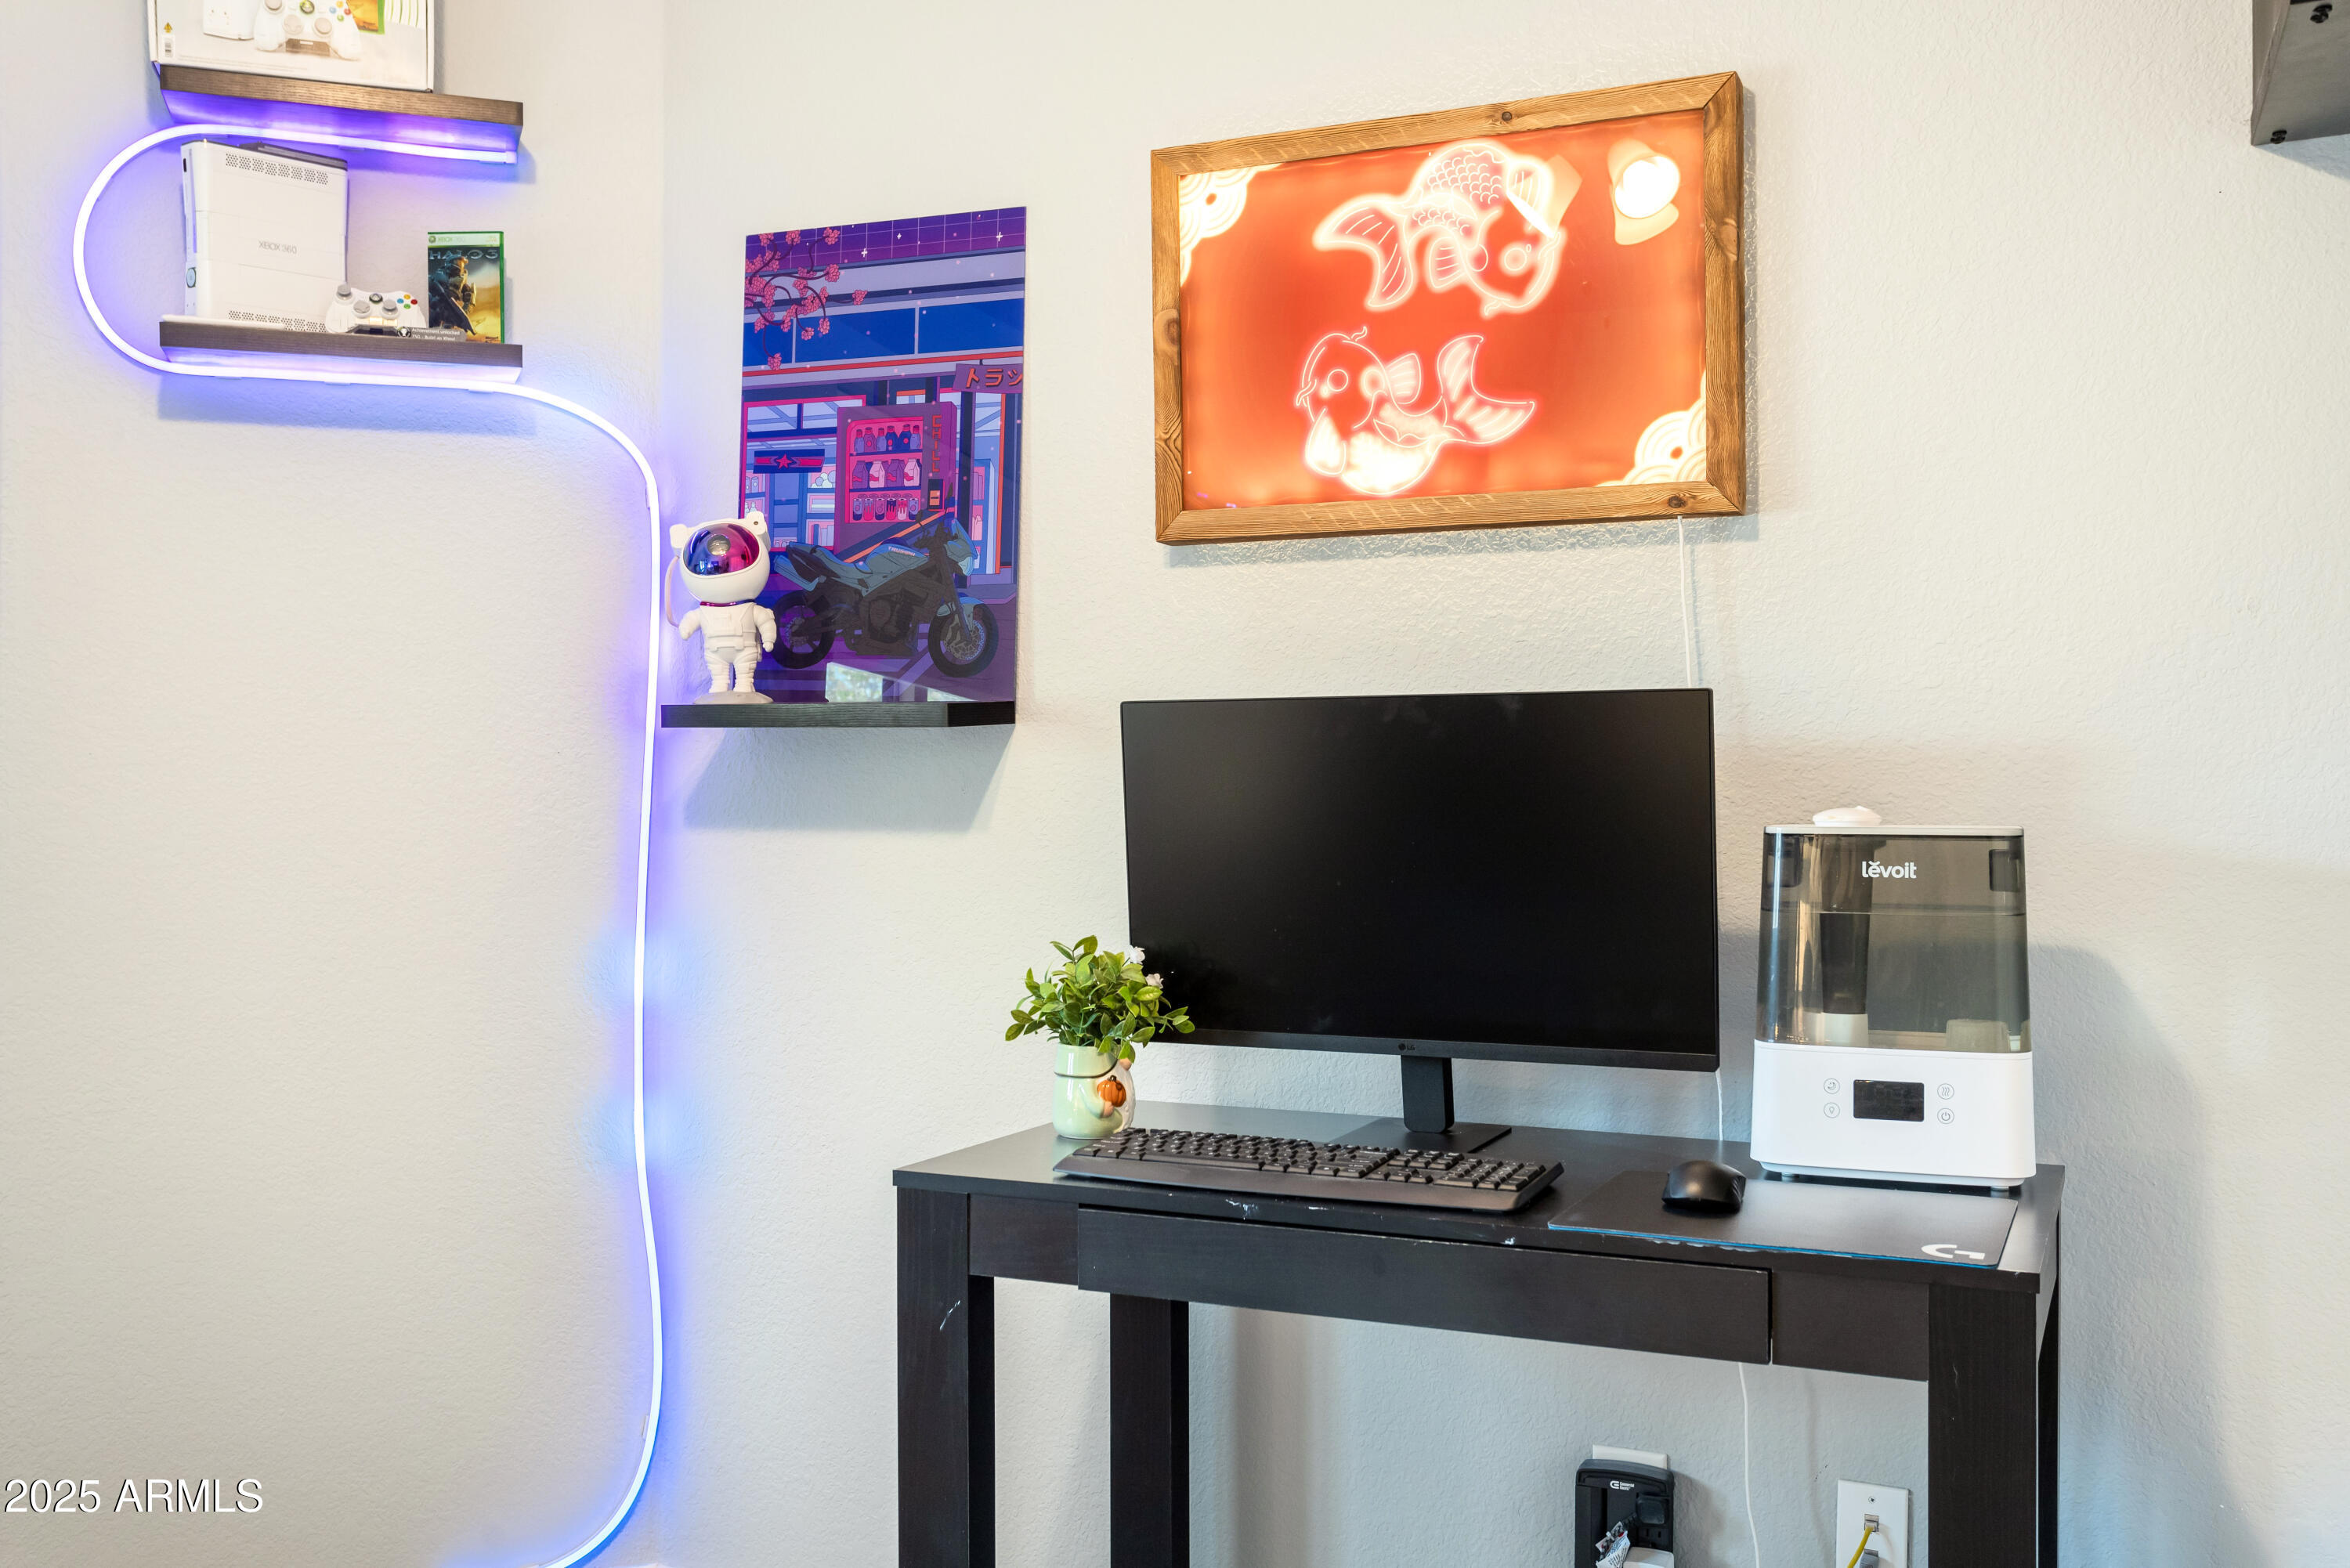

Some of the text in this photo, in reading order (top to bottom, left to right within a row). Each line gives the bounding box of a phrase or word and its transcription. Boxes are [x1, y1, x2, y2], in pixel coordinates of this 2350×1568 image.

[258, 240, 280, 251] XBOX
[428, 249, 498, 260] HALO 3
[932, 415, 942, 472] CHILL
